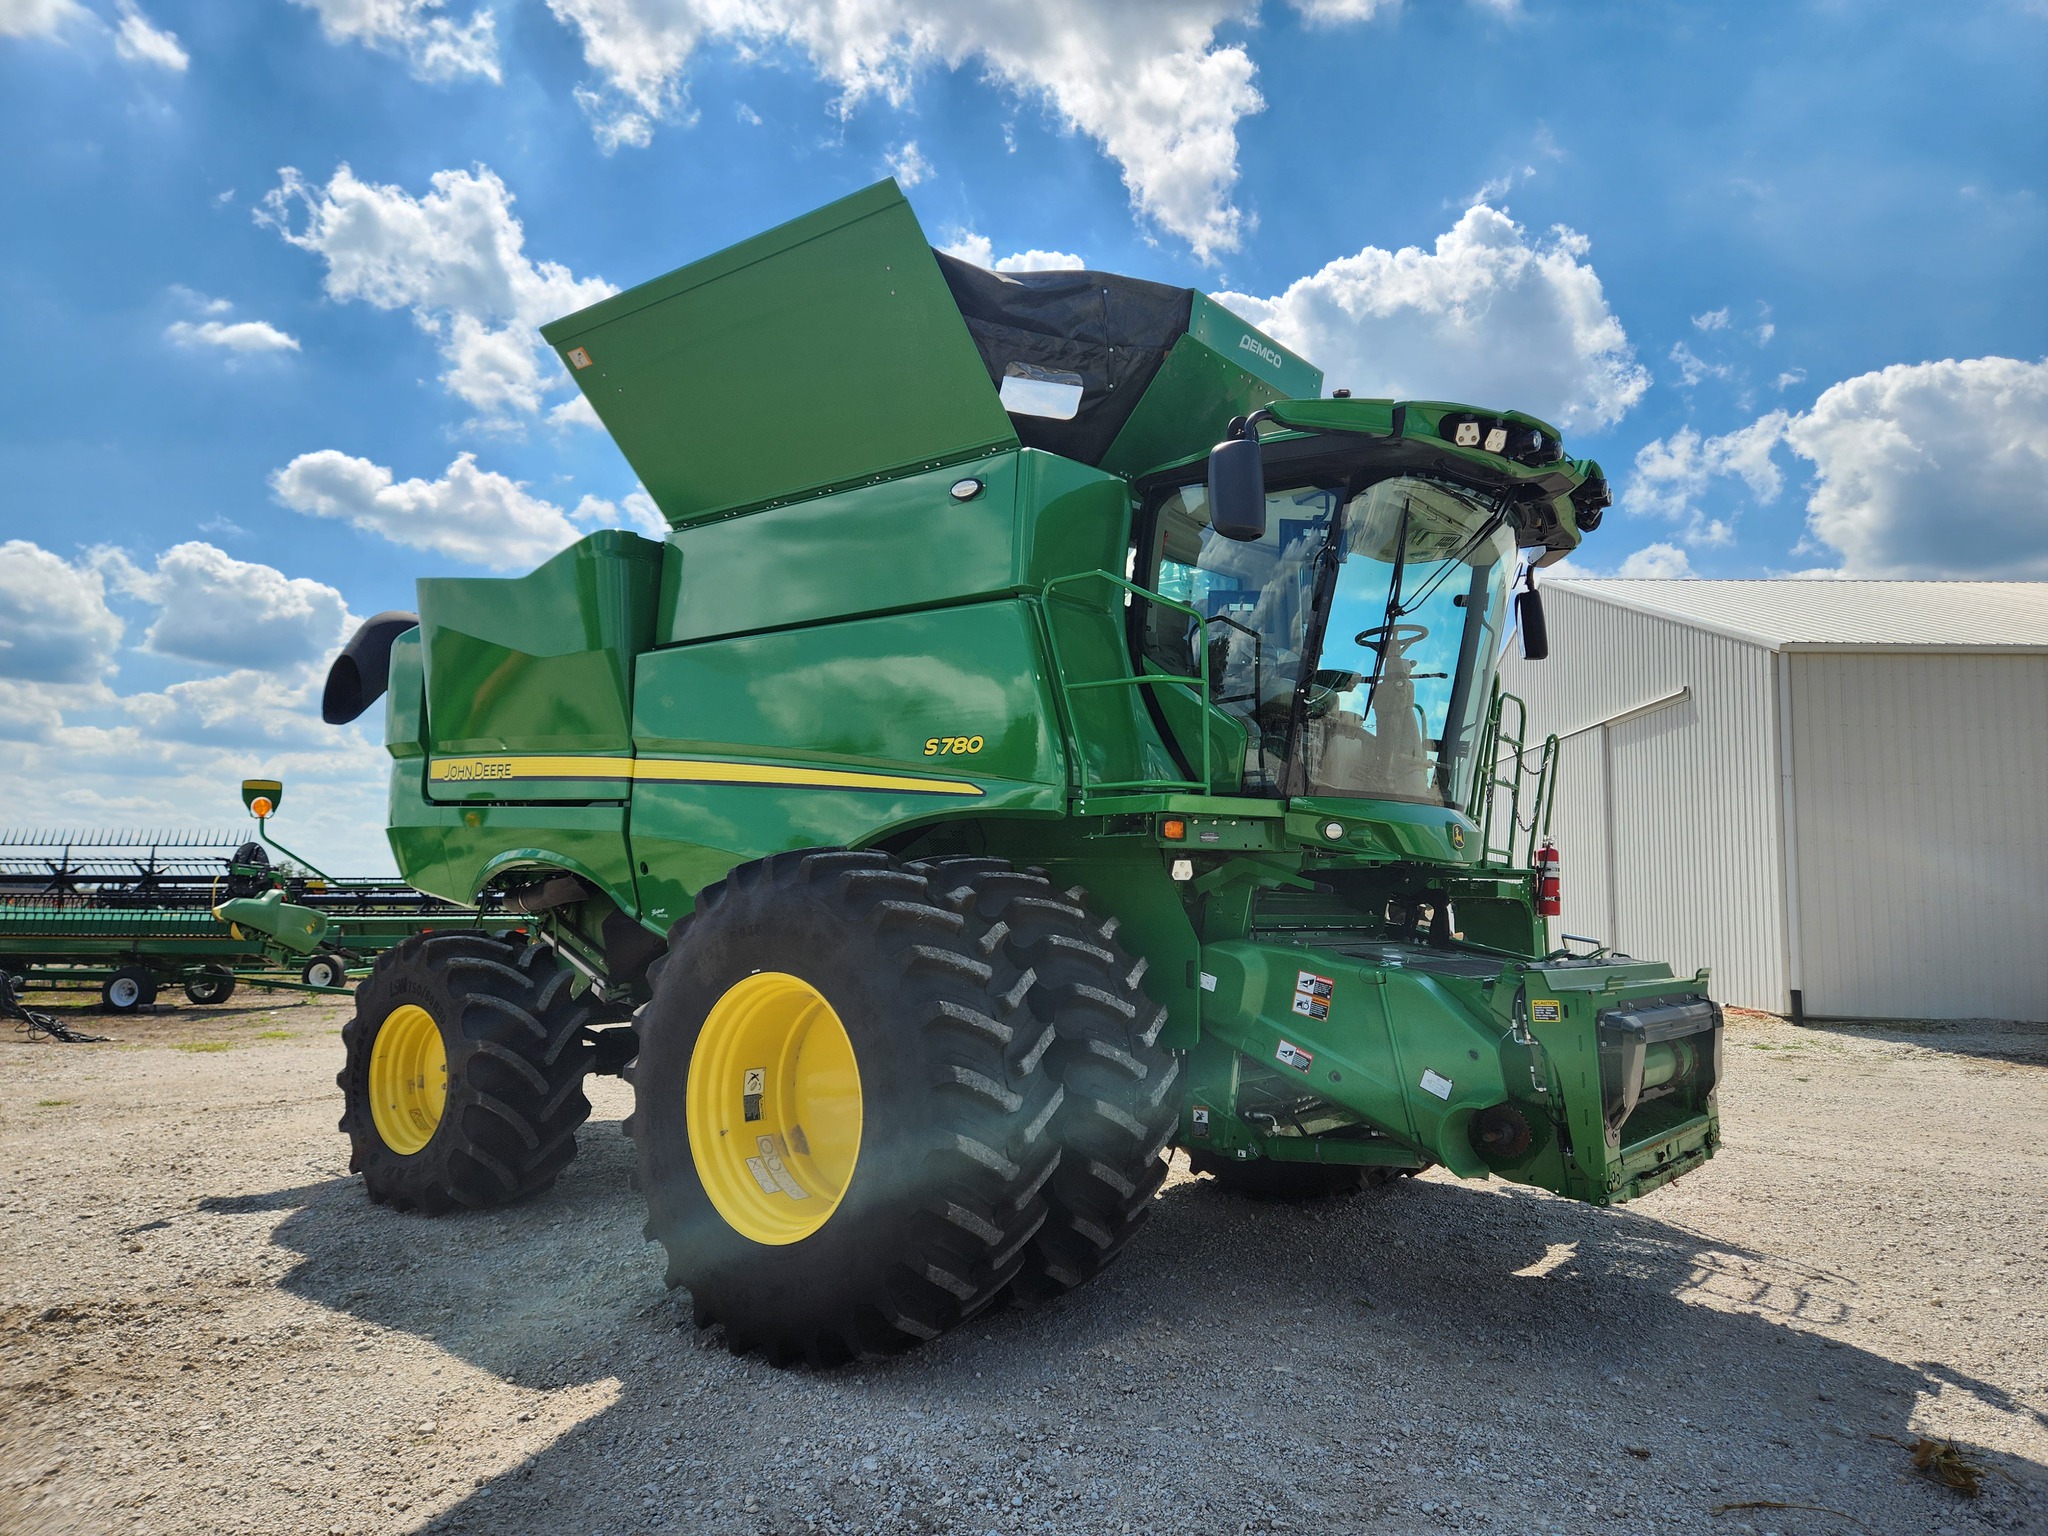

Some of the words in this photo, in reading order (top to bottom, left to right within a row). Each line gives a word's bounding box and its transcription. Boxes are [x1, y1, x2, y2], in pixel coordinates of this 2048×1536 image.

[1239, 334, 1282, 369] DEMCO
[923, 735, 984, 756] S780
[444, 763, 473, 779] JOHN
[474, 762, 512, 778] DEERE
